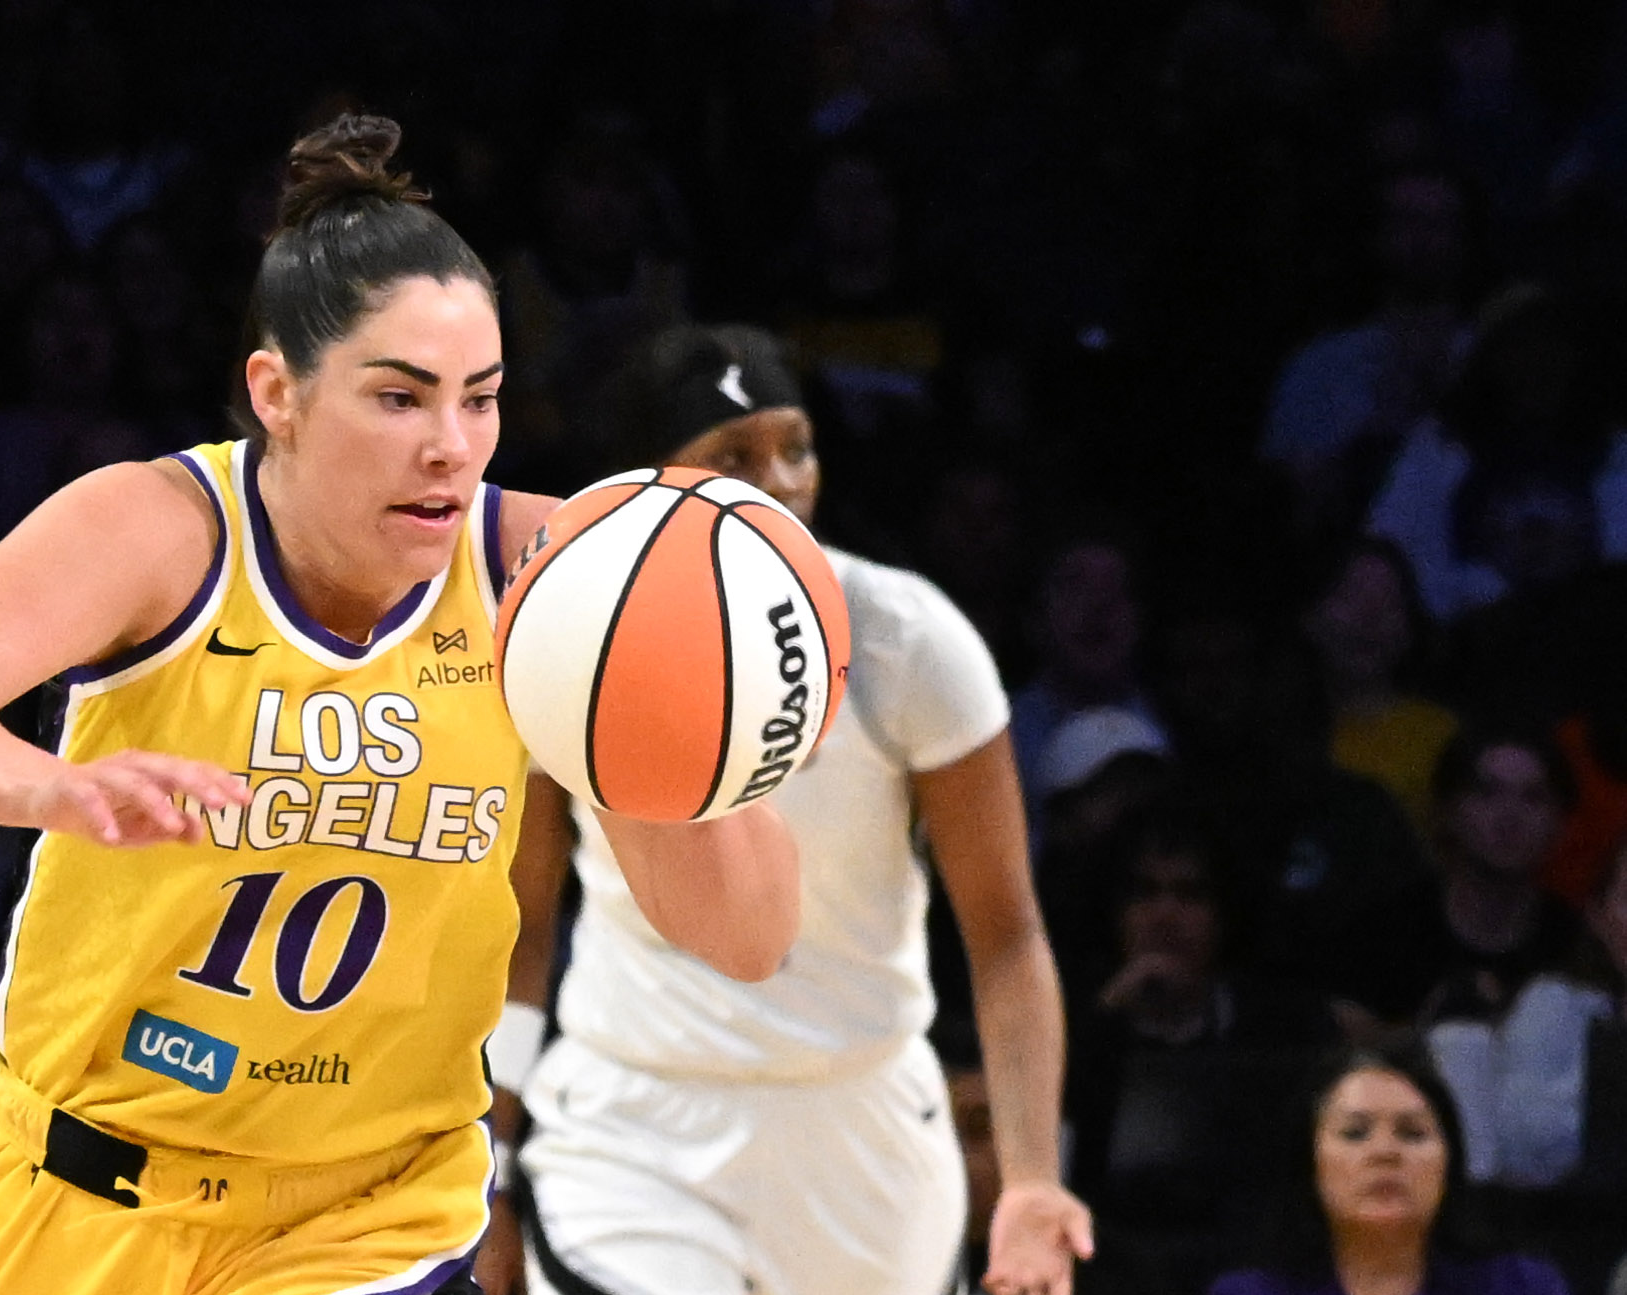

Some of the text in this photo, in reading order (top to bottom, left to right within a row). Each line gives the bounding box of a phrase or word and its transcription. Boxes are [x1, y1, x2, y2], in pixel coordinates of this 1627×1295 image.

[417, 661, 495, 689] Albert
[727, 593, 808, 809] Wilson
[248, 688, 422, 777] LOS
[171, 772, 507, 863] NGELES
[177, 870, 390, 1014] 10
[139, 1027, 216, 1081] UCLA
